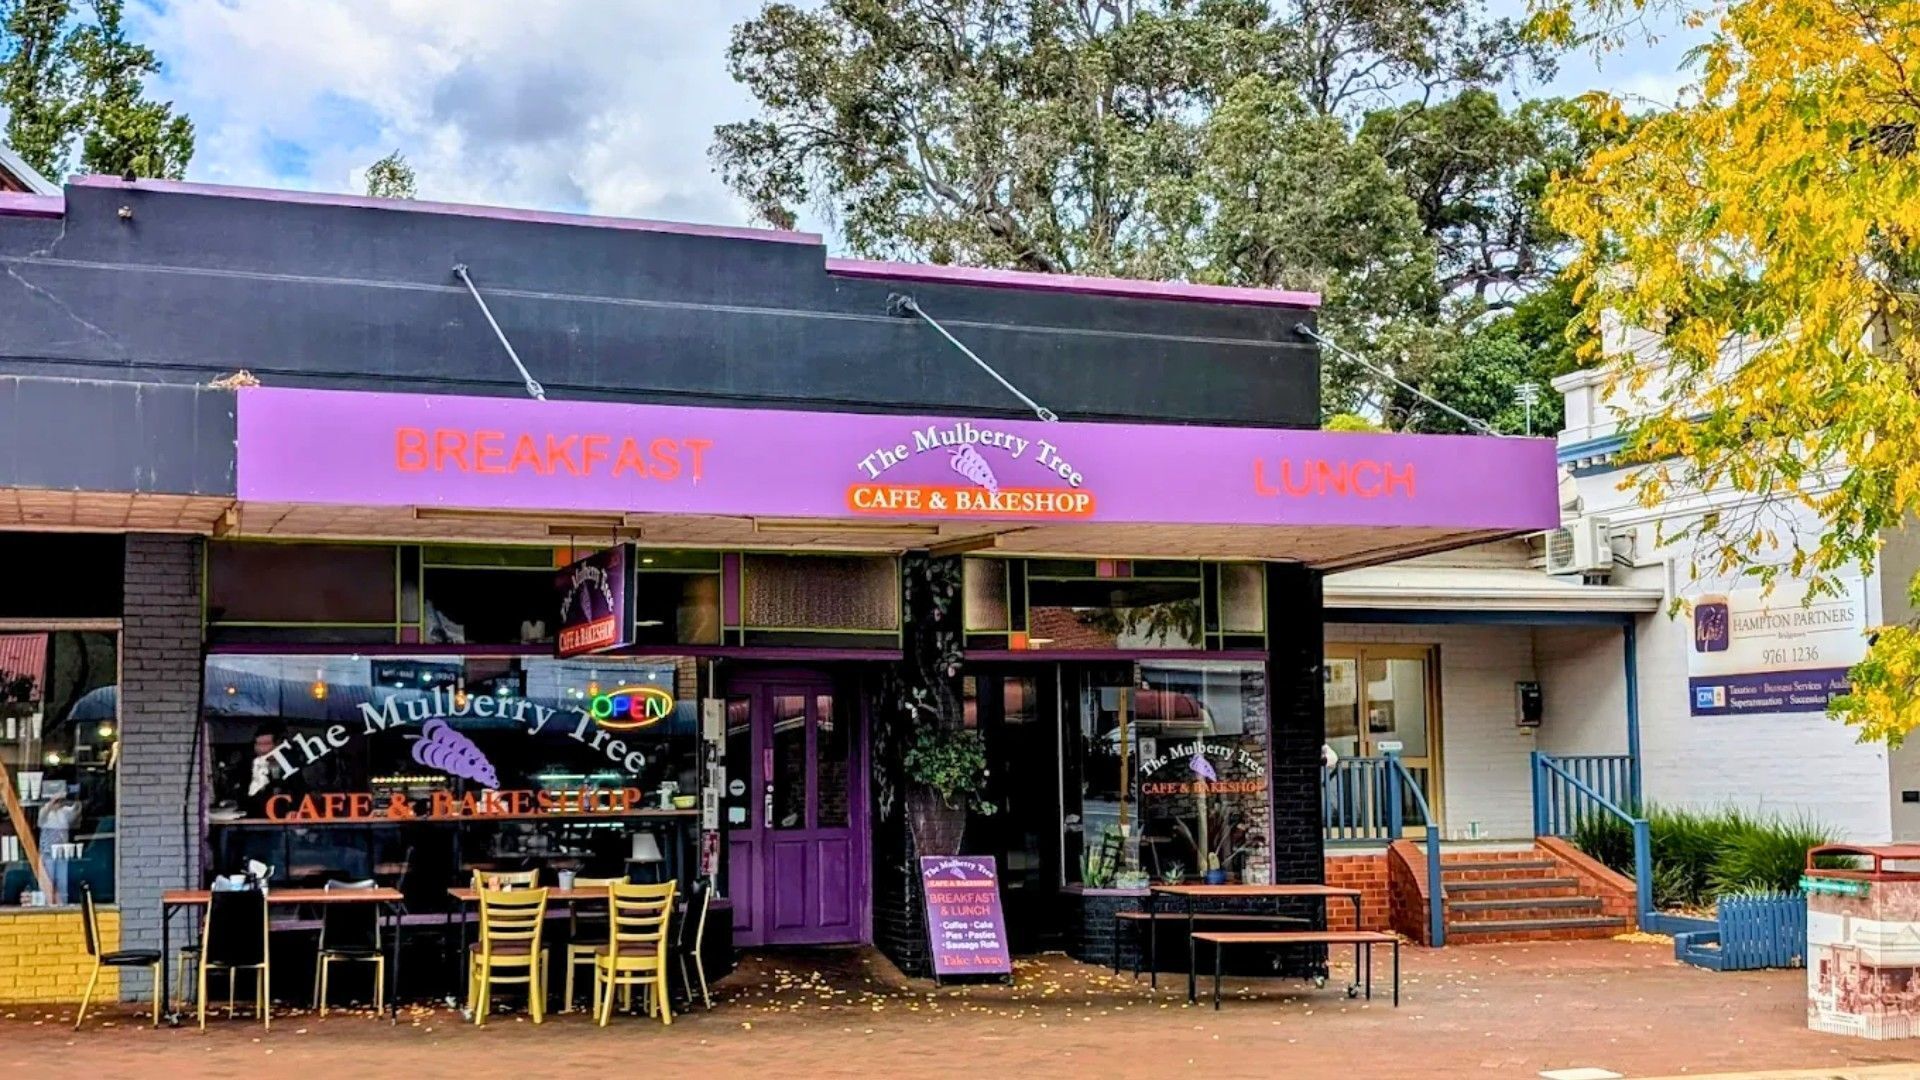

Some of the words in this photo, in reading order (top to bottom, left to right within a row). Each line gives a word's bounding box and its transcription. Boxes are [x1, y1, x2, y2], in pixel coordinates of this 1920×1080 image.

[395, 427, 713, 480] BREAKFAST
[857, 443, 909, 480] The
[912, 422, 1029, 458] Mulberry
[1036, 439, 1082, 487] Tree
[1253, 459, 1416, 498] LUNCH
[854, 488, 921, 510] CAFE
[928, 491, 947, 510] &
[955, 490, 1089, 513] BAKESHOP
[1733, 613, 1791, 632] HAMPTON
[1794, 608, 1854, 627] PARTNERS
[1763, 648, 1787, 664] 9761
[1793, 646, 1819, 662] 1236
[1729, 684, 1757, 695] Taxation
[1794, 680, 1822, 691] Services
[592, 695, 668, 720] OPEN
[1730, 697, 1783, 709] Superannuation
[265, 719, 350, 780] The
[357, 685, 556, 735] Mulberry
[567, 707, 646, 774] Tree
[1139, 754, 1168, 777] The
[1169, 741, 1234, 760] Mulberry
[1238, 749, 1265, 776] Tree
[1142, 783, 1177, 795] CAFE
[1180, 783, 1189, 794] &
[1193, 780, 1267, 794] BAKESHOP
[265, 793, 373, 822] CAFE
[386, 795, 416, 818] &
[432, 787, 642, 818] BAKESHOP
[924, 865, 940, 878] The
[939, 859, 977, 871] Mulberry
[977, 863, 995, 878] Tree
[930, 893, 995, 904] BREAKFAST
[940, 905, 949, 916] &
[951, 905, 990, 916] LUNCH
[974, 921, 994, 929] Cake
[946, 931, 963, 939] Pies
[968, 931, 996, 939] Pasties
[945, 941, 979, 950] Sausage
[980, 940, 1000, 949] Rolls
[941, 955, 969, 966] Take
[975, 954, 1003, 967] Away
